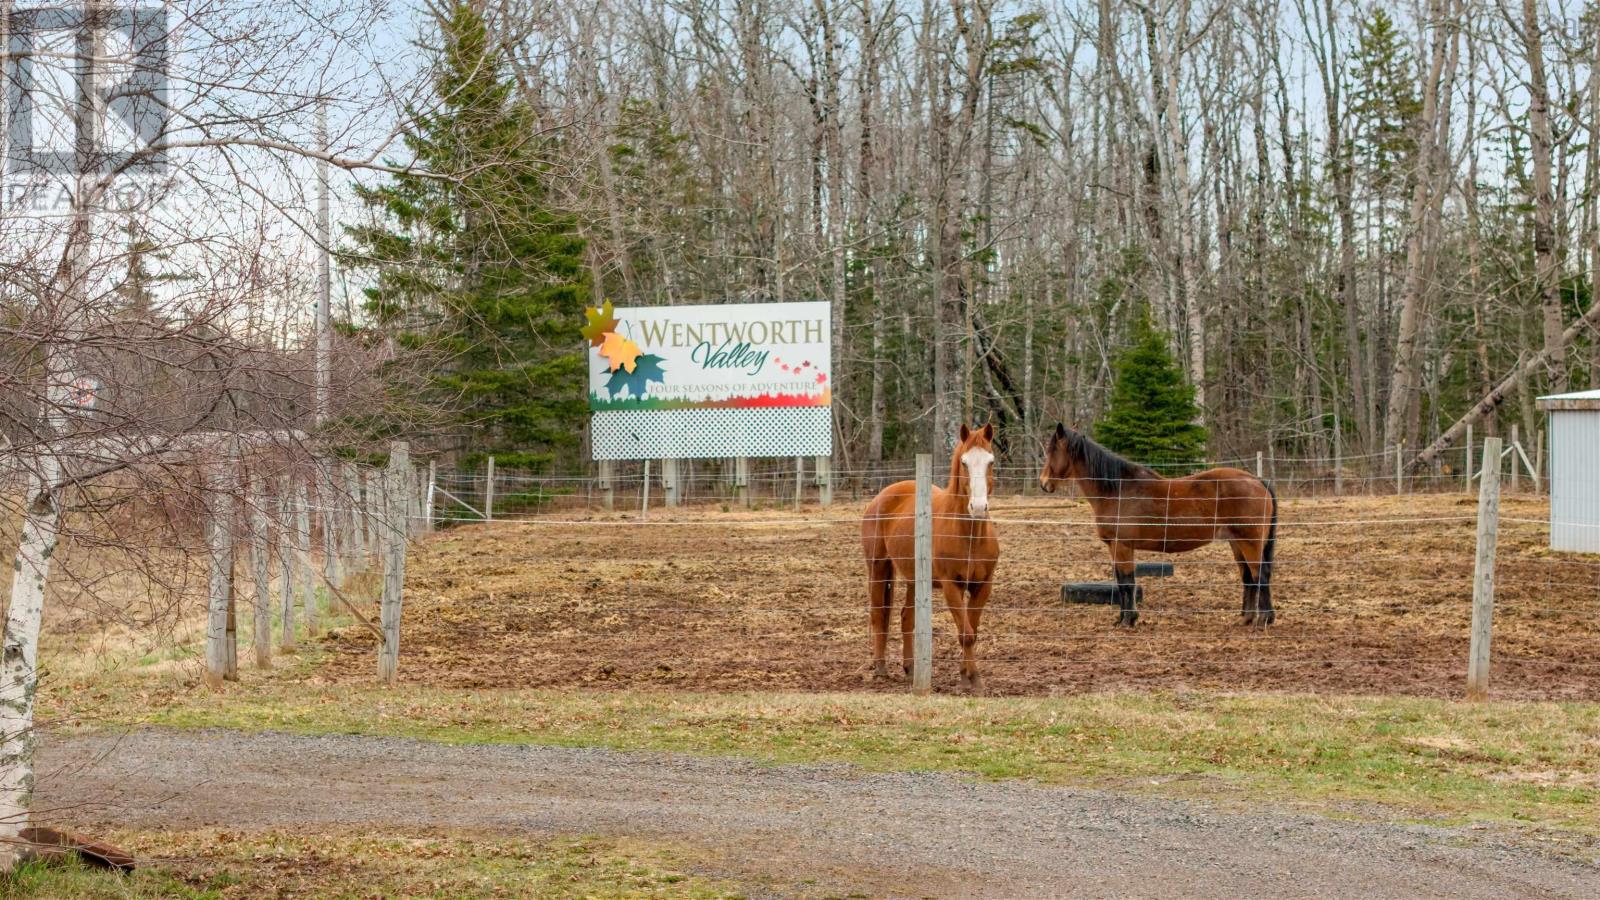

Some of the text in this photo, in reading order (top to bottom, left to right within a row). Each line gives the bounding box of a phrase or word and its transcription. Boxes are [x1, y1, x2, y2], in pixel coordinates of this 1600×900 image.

[639, 319, 824, 347] WENTWORTH
[691, 338, 770, 376] Valley
[650, 381, 817, 394] FOUR SEASONS OF ADVENTURE
